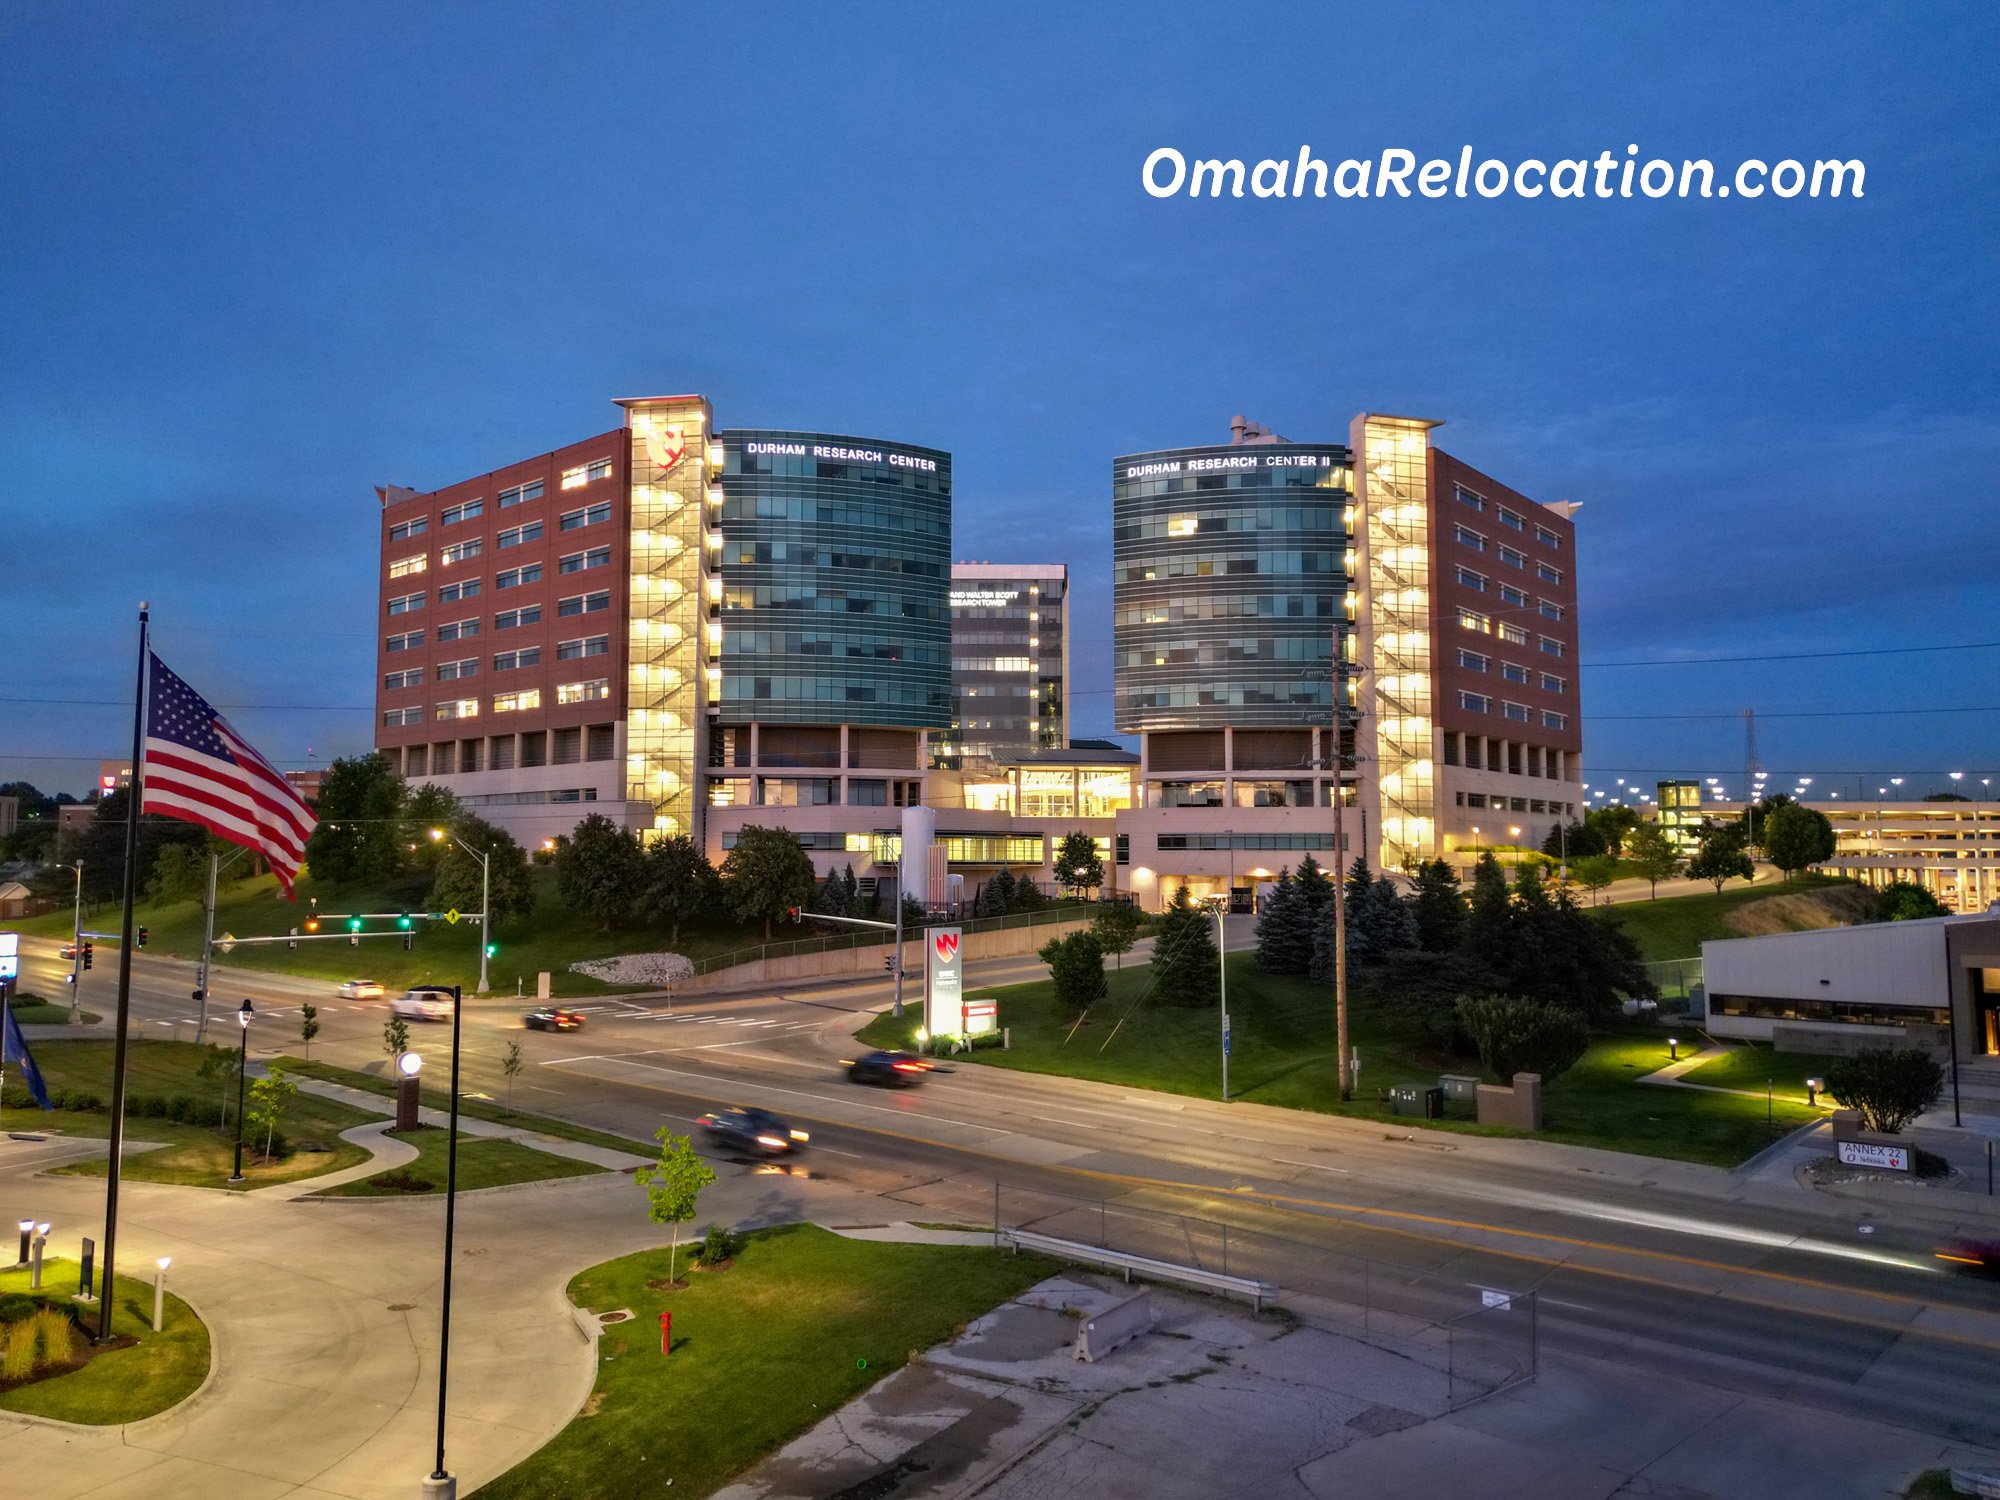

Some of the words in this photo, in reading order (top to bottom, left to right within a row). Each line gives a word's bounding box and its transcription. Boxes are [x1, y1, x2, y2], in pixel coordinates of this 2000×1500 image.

[747, 442, 806, 455] DURHAM
[813, 445, 882, 462] RESEARCH
[889, 454, 936, 472] CENTER
[1127, 461, 1181, 478] DURHAM
[1187, 456, 1258, 471] RESEARCH
[1266, 455, 1317, 467] CENTER
[1322, 456, 1331, 467] II
[966, 591, 994, 599] WALTER
[995, 591, 1019, 599] SCOTT
[1844, 1143, 1885, 1156] ANNEX
[1888, 1148, 1902, 1158] 22
